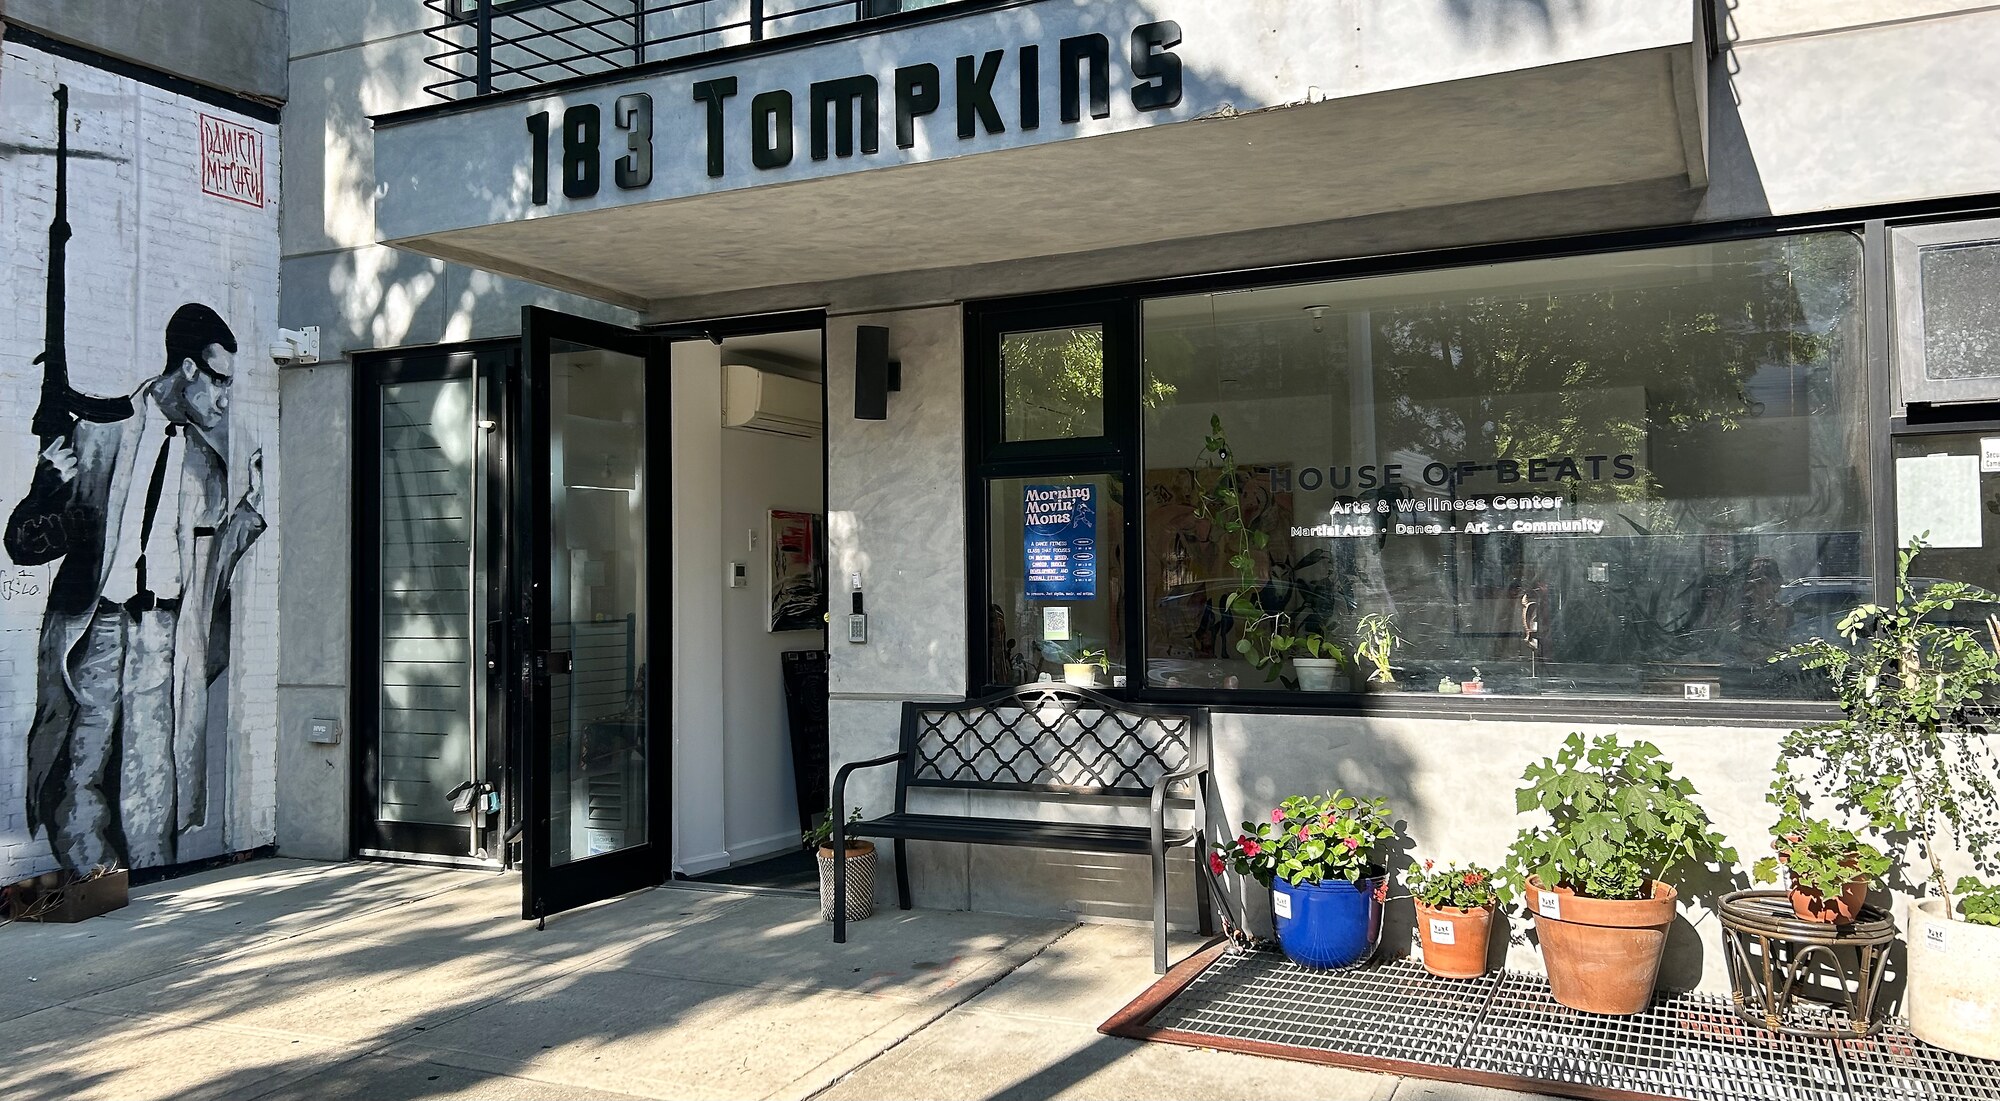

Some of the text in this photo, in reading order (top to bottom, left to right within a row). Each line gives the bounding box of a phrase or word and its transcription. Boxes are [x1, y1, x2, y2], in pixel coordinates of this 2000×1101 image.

[525, 92, 654, 205] 183
[1269, 454, 1636, 493] HOUSE OF BEATS
[1025, 486, 1090, 501] Morning
[1329, 495, 1564, 515] Arts & Wellness Center
[1025, 513, 1071, 526] Moms
[1290, 517, 1605, 537] Martial Arts Dance Art Community
